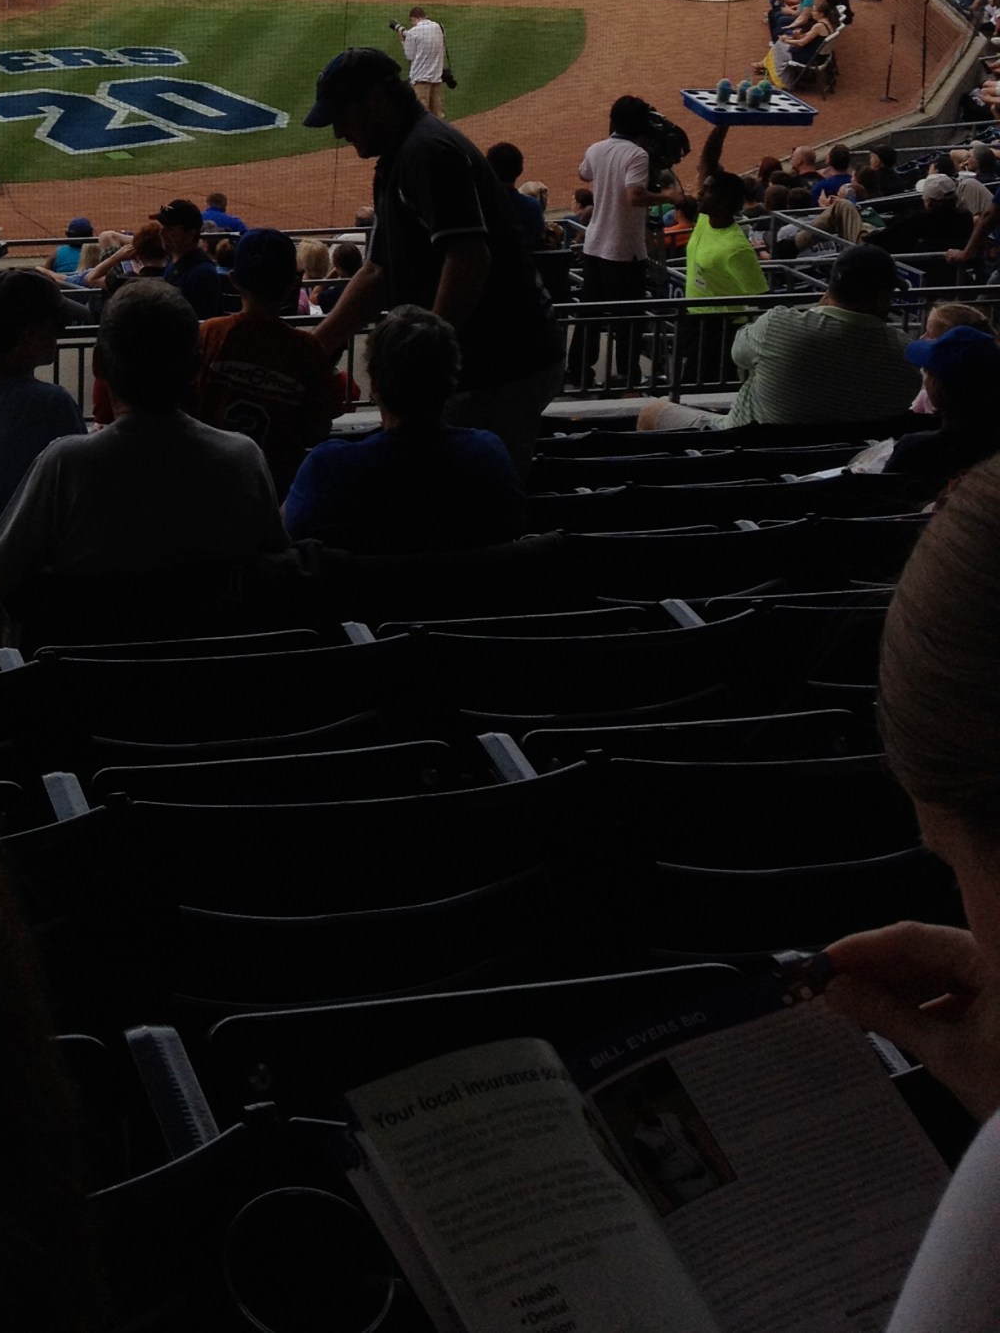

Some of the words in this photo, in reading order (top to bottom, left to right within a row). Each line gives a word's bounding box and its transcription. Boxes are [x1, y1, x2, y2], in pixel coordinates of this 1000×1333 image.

[589, 1046, 625, 1070] BILL
[626, 1019, 680, 1050] EVERS
[371, 1103, 415, 1129] Your
[417, 1085, 463, 1112] local
[464, 1068, 541, 1097] insurance
